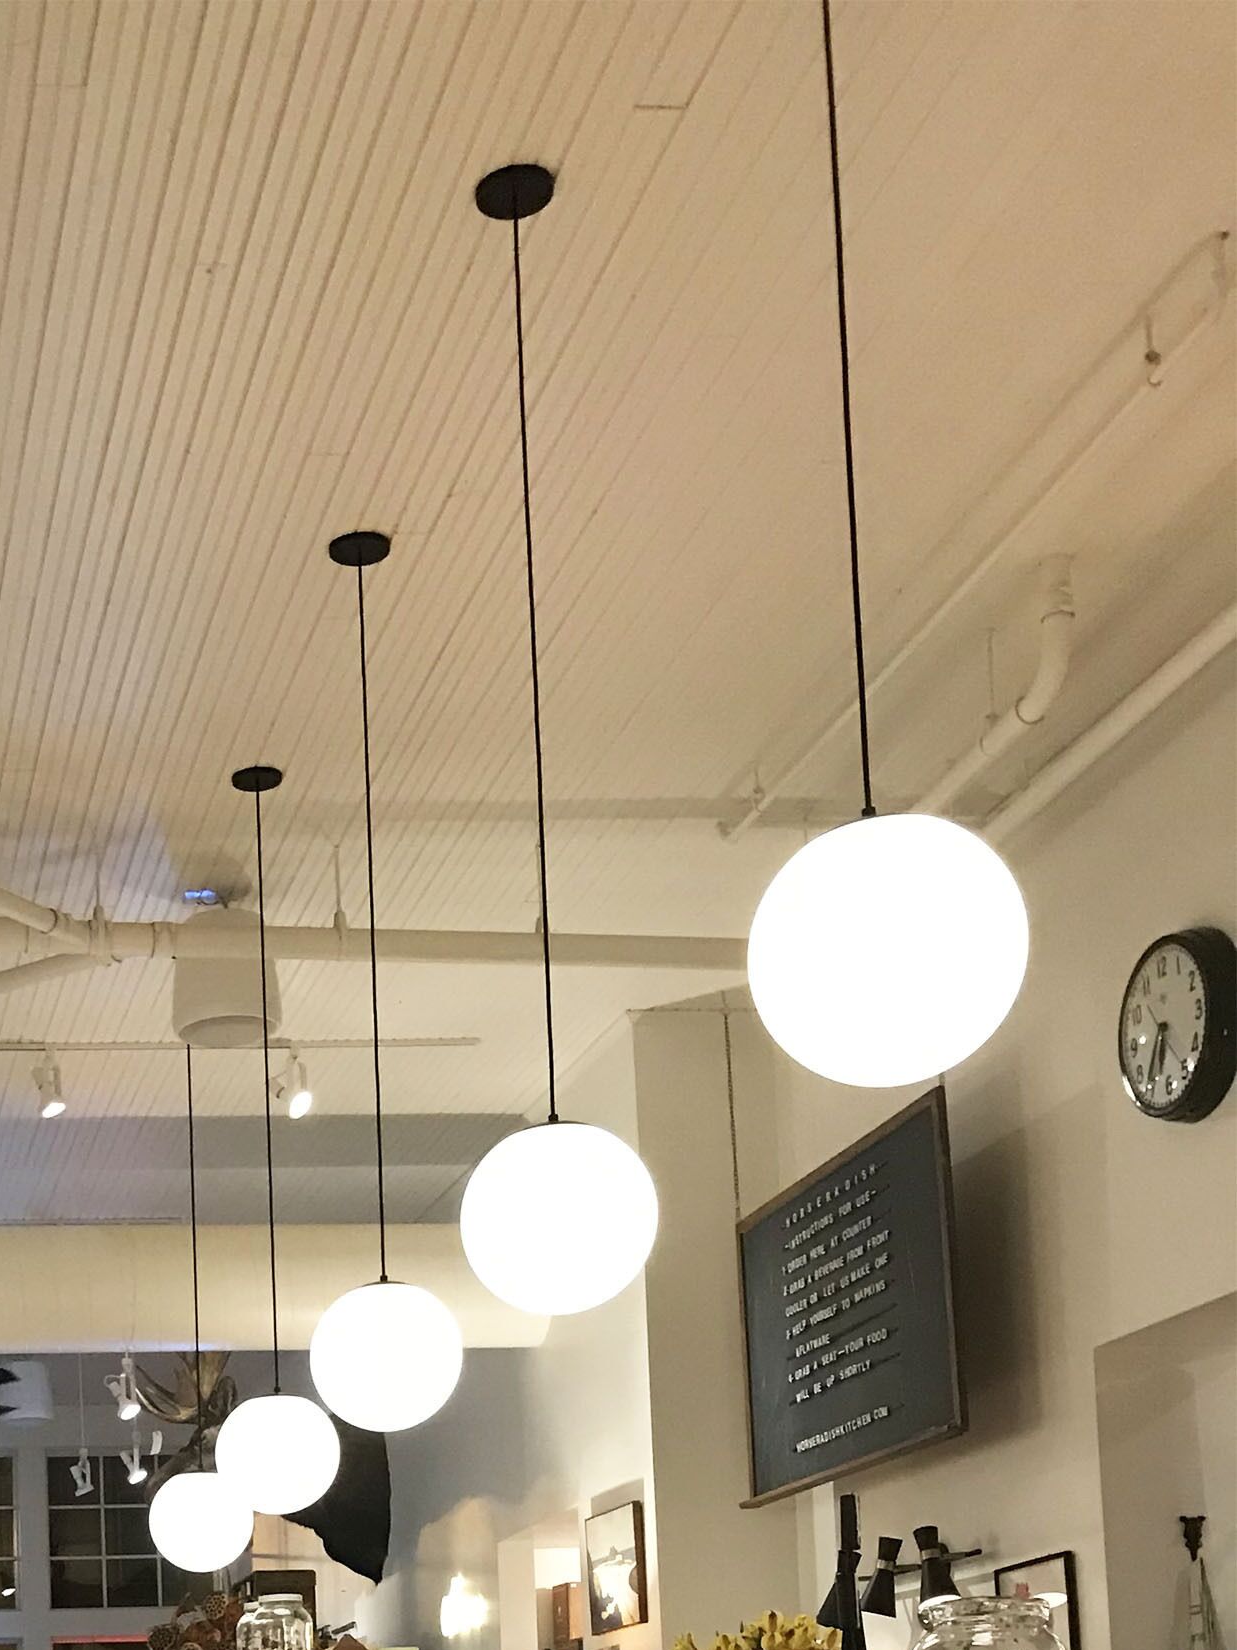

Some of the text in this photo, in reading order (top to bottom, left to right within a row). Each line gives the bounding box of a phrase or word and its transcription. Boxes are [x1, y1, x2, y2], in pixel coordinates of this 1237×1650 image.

[1157, 955, 1168, 979] 12
[1188, 970, 1196, 992] 2
[1132, 1004, 1142, 1026] 10
[1195, 998, 1204, 1020] 3
[1131, 1037, 1138, 1058] 9
[1191, 1031, 1200, 1053] 4
[1136, 1064, 1144, 1085] 8
[1180, 1058, 1191, 1080] 5
[1165, 1074, 1174, 1096] 6
[839, 1202, 852, 1217] FOR
[830, 1235, 839, 1248] AT
[842, 1216, 872, 1240] COUNTER
[846, 1245, 864, 1262] FROM
[867, 1230, 890, 1250] FRONT
[810, 1292, 818, 1304] OR
[823, 1283, 835, 1297] LET
[874, 1252, 889, 1269] ONE
[841, 1298, 851, 1310] TO
[854, 1279, 886, 1303] NAPKINS
[866, 1328, 887, 1346] FOOD
[795, 1359, 871, 1403] WILL BE UP SHORTLY
